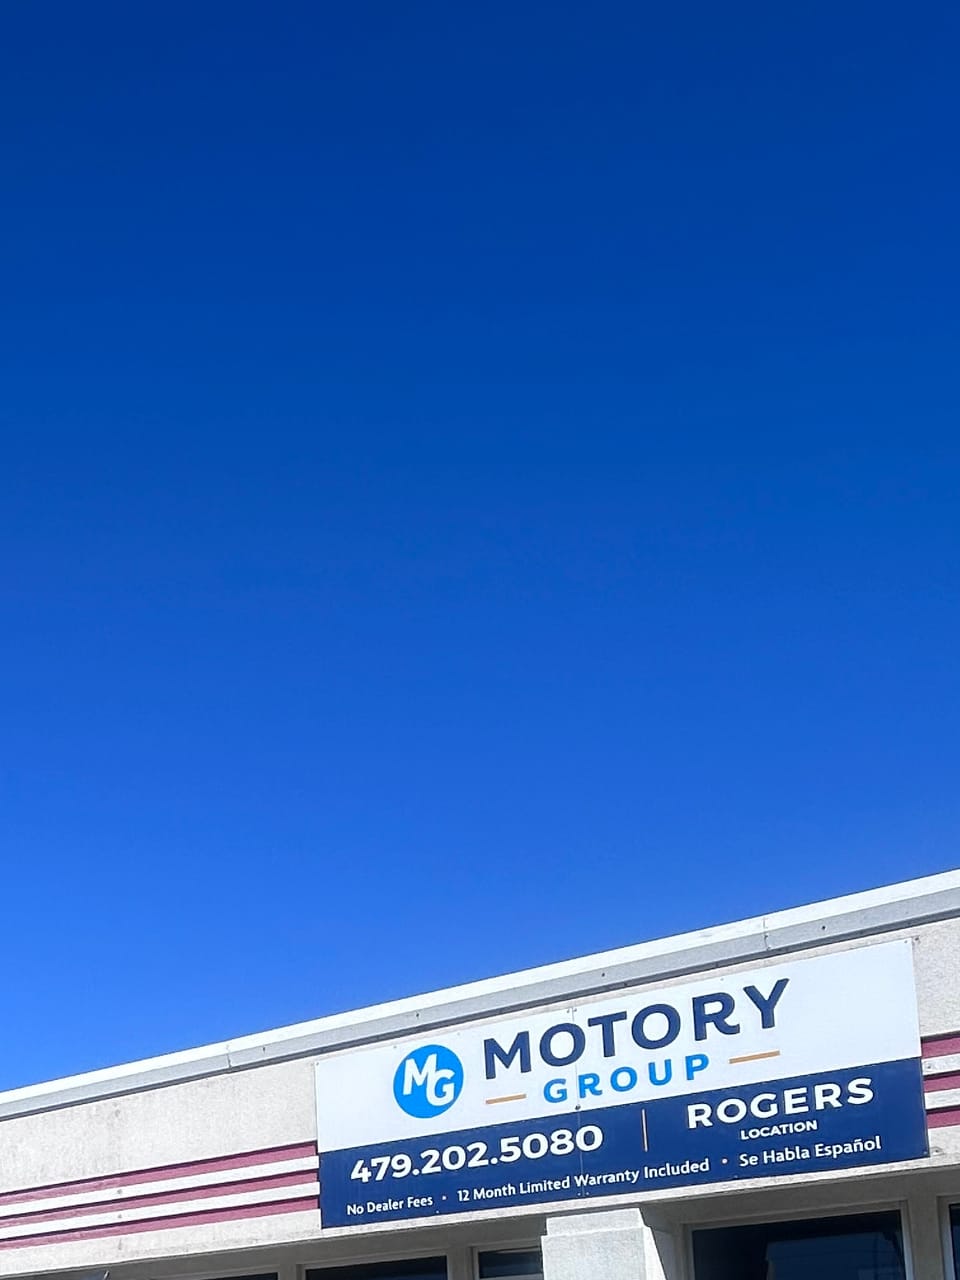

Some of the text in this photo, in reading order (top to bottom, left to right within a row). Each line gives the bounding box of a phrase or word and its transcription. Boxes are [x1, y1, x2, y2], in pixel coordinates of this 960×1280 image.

[483, 978, 790, 1079] MOTORY
[402, 1053, 455, 1106] MG
[543, 1053, 709, 1103] GROUP
[687, 1077, 874, 1129] ROGERS
[349, 1125, 604, 1183] 479.202.5080
[740, 1120, 818, 1140] LOCATION
[346, 1136, 882, 1216] No Dealer Fees 12 Month Limited Warranty Included Se Habla Español
